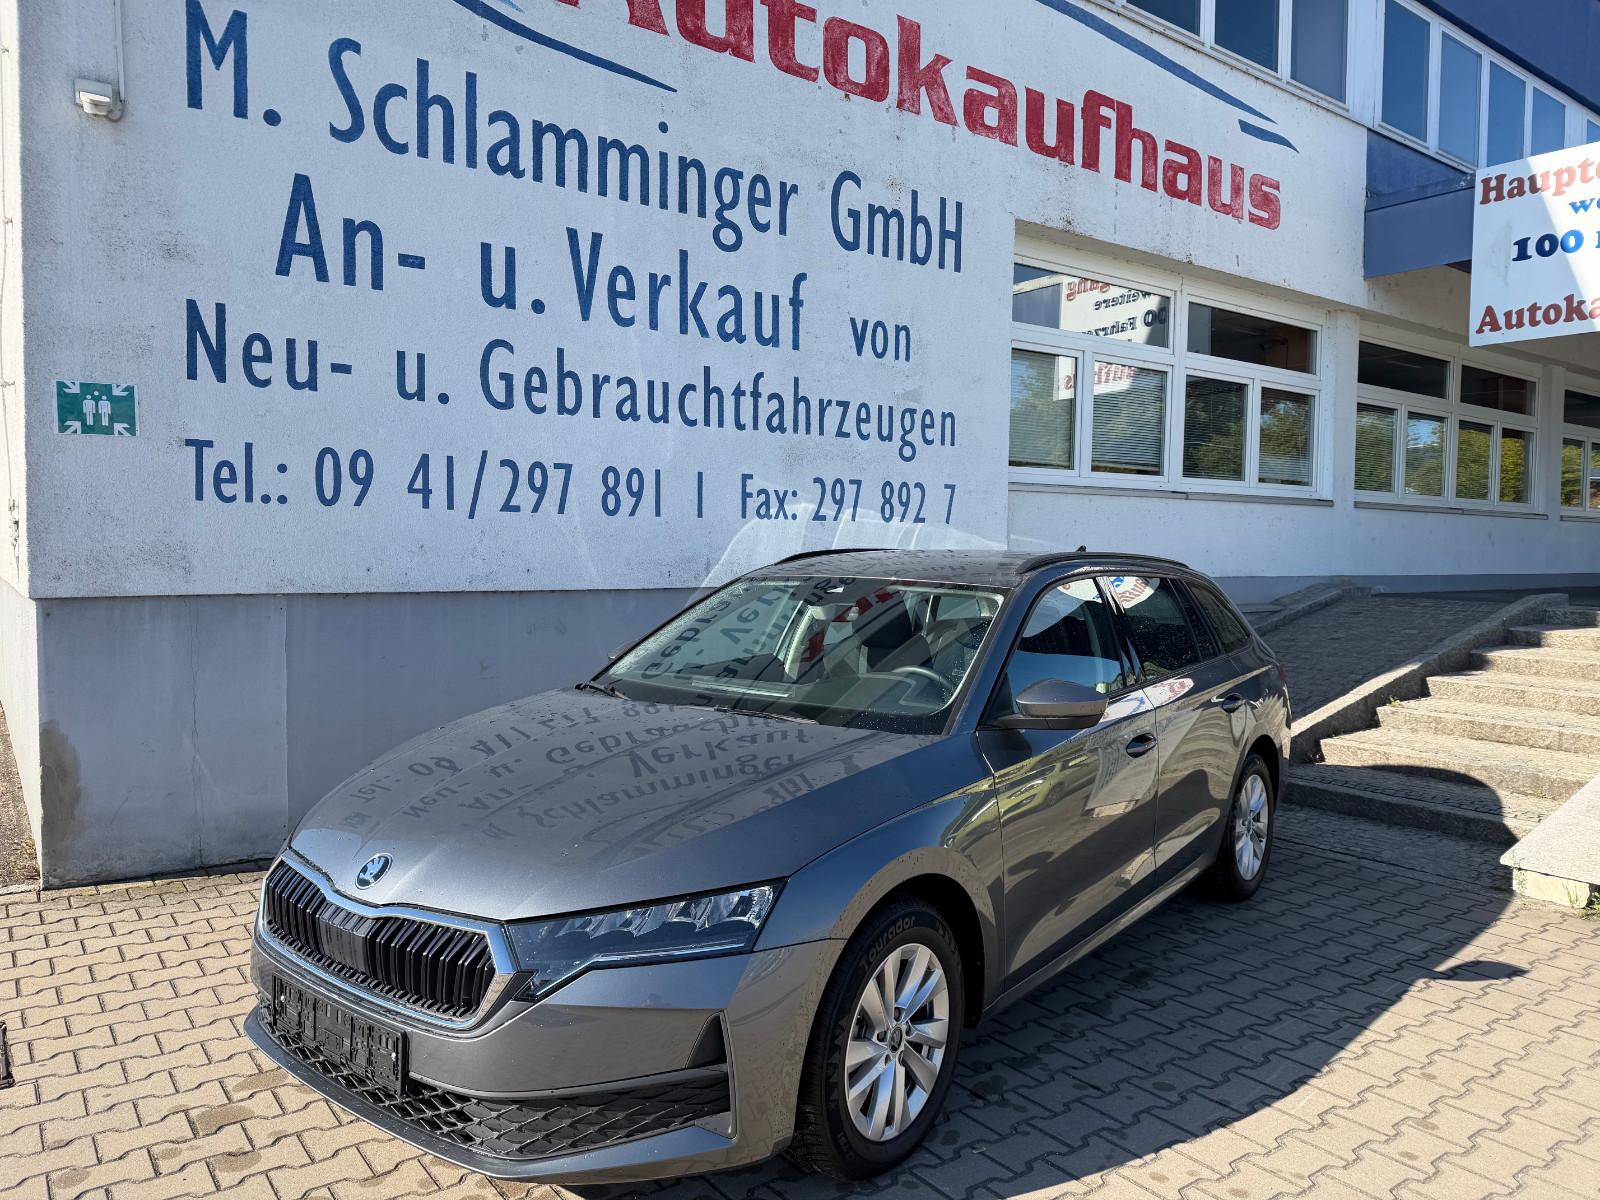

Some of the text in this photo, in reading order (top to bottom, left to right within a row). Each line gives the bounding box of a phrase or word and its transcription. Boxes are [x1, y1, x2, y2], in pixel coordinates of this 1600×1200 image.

[186, 0, 962, 273] M. Schlamminger GmbH
[557, 0, 1281, 230] utokaufhaus
[1479, 157, 1600, 205] Haupt
[275, 173, 911, 362] An- u. Verkauf von
[1512, 229, 1584, 262] 100
[185, 299, 956, 462] Neu- u. Gebrauchtfahrzeugen
[185, 439, 288, 505] Tel.:
[315, 447, 374, 507] 09
[742, 474, 798, 521] Fax:
[812, 477, 863, 522] 297
[881, 481, 926, 523] 892
[943, 484, 956, 525] 7
